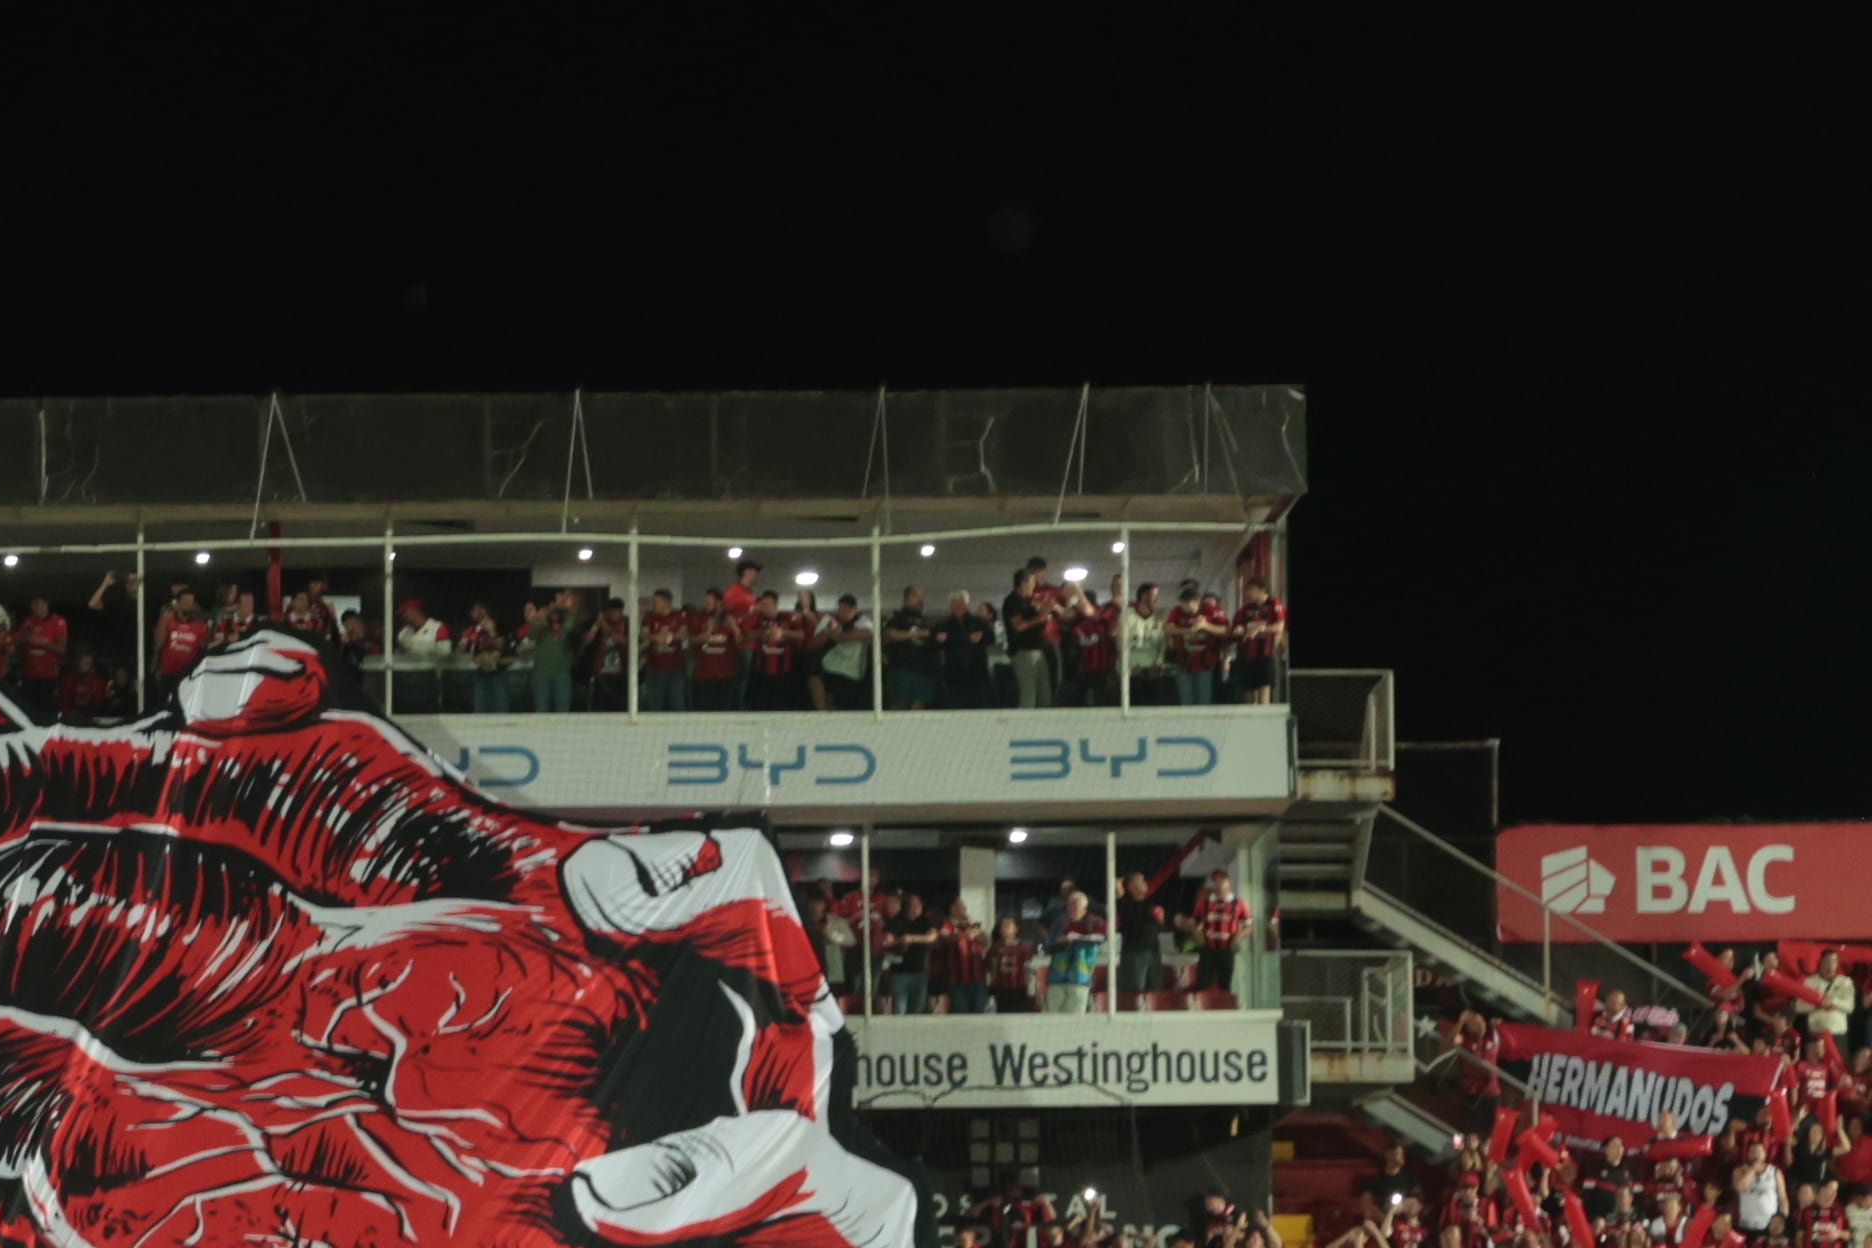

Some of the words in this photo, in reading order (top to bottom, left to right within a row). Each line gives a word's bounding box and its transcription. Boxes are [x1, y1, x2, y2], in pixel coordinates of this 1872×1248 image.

[668, 744, 877, 786] BYD
[1009, 737, 1219, 780] BYD
[1635, 844, 1796, 914] BAC
[990, 1042, 1269, 1092] Westinghouse
[1529, 1052, 1735, 1136] HERMANUDOS
